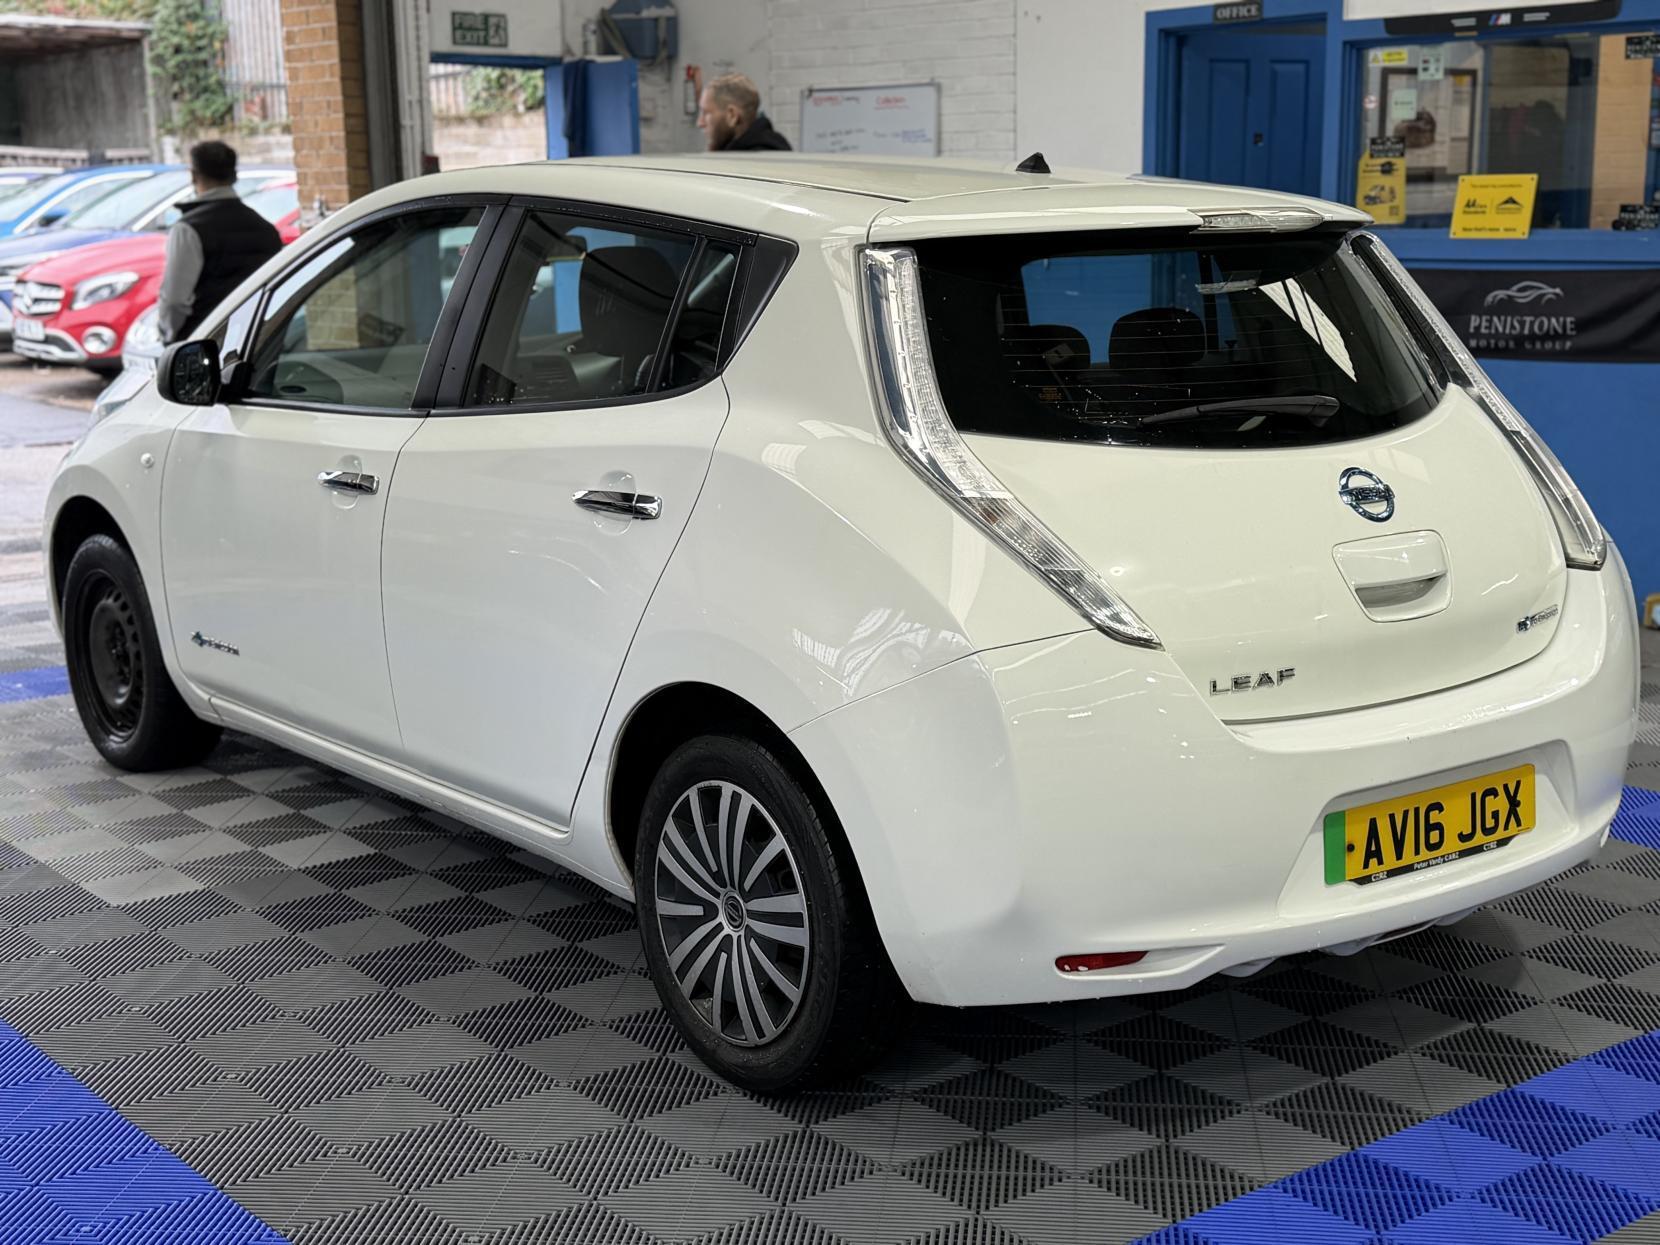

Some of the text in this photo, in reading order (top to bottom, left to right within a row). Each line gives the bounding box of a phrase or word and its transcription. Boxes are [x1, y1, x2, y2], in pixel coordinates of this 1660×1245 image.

[456, 30, 486, 43] EXIT
[1469, 314, 1577, 335] PENISTONE
[1469, 339, 1574, 351] MOTOR GROUP
[1209, 667, 1295, 696] LEAF
[1362, 780, 1521, 870] AV16 JGX
[1413, 860, 1429, 870] Peter
